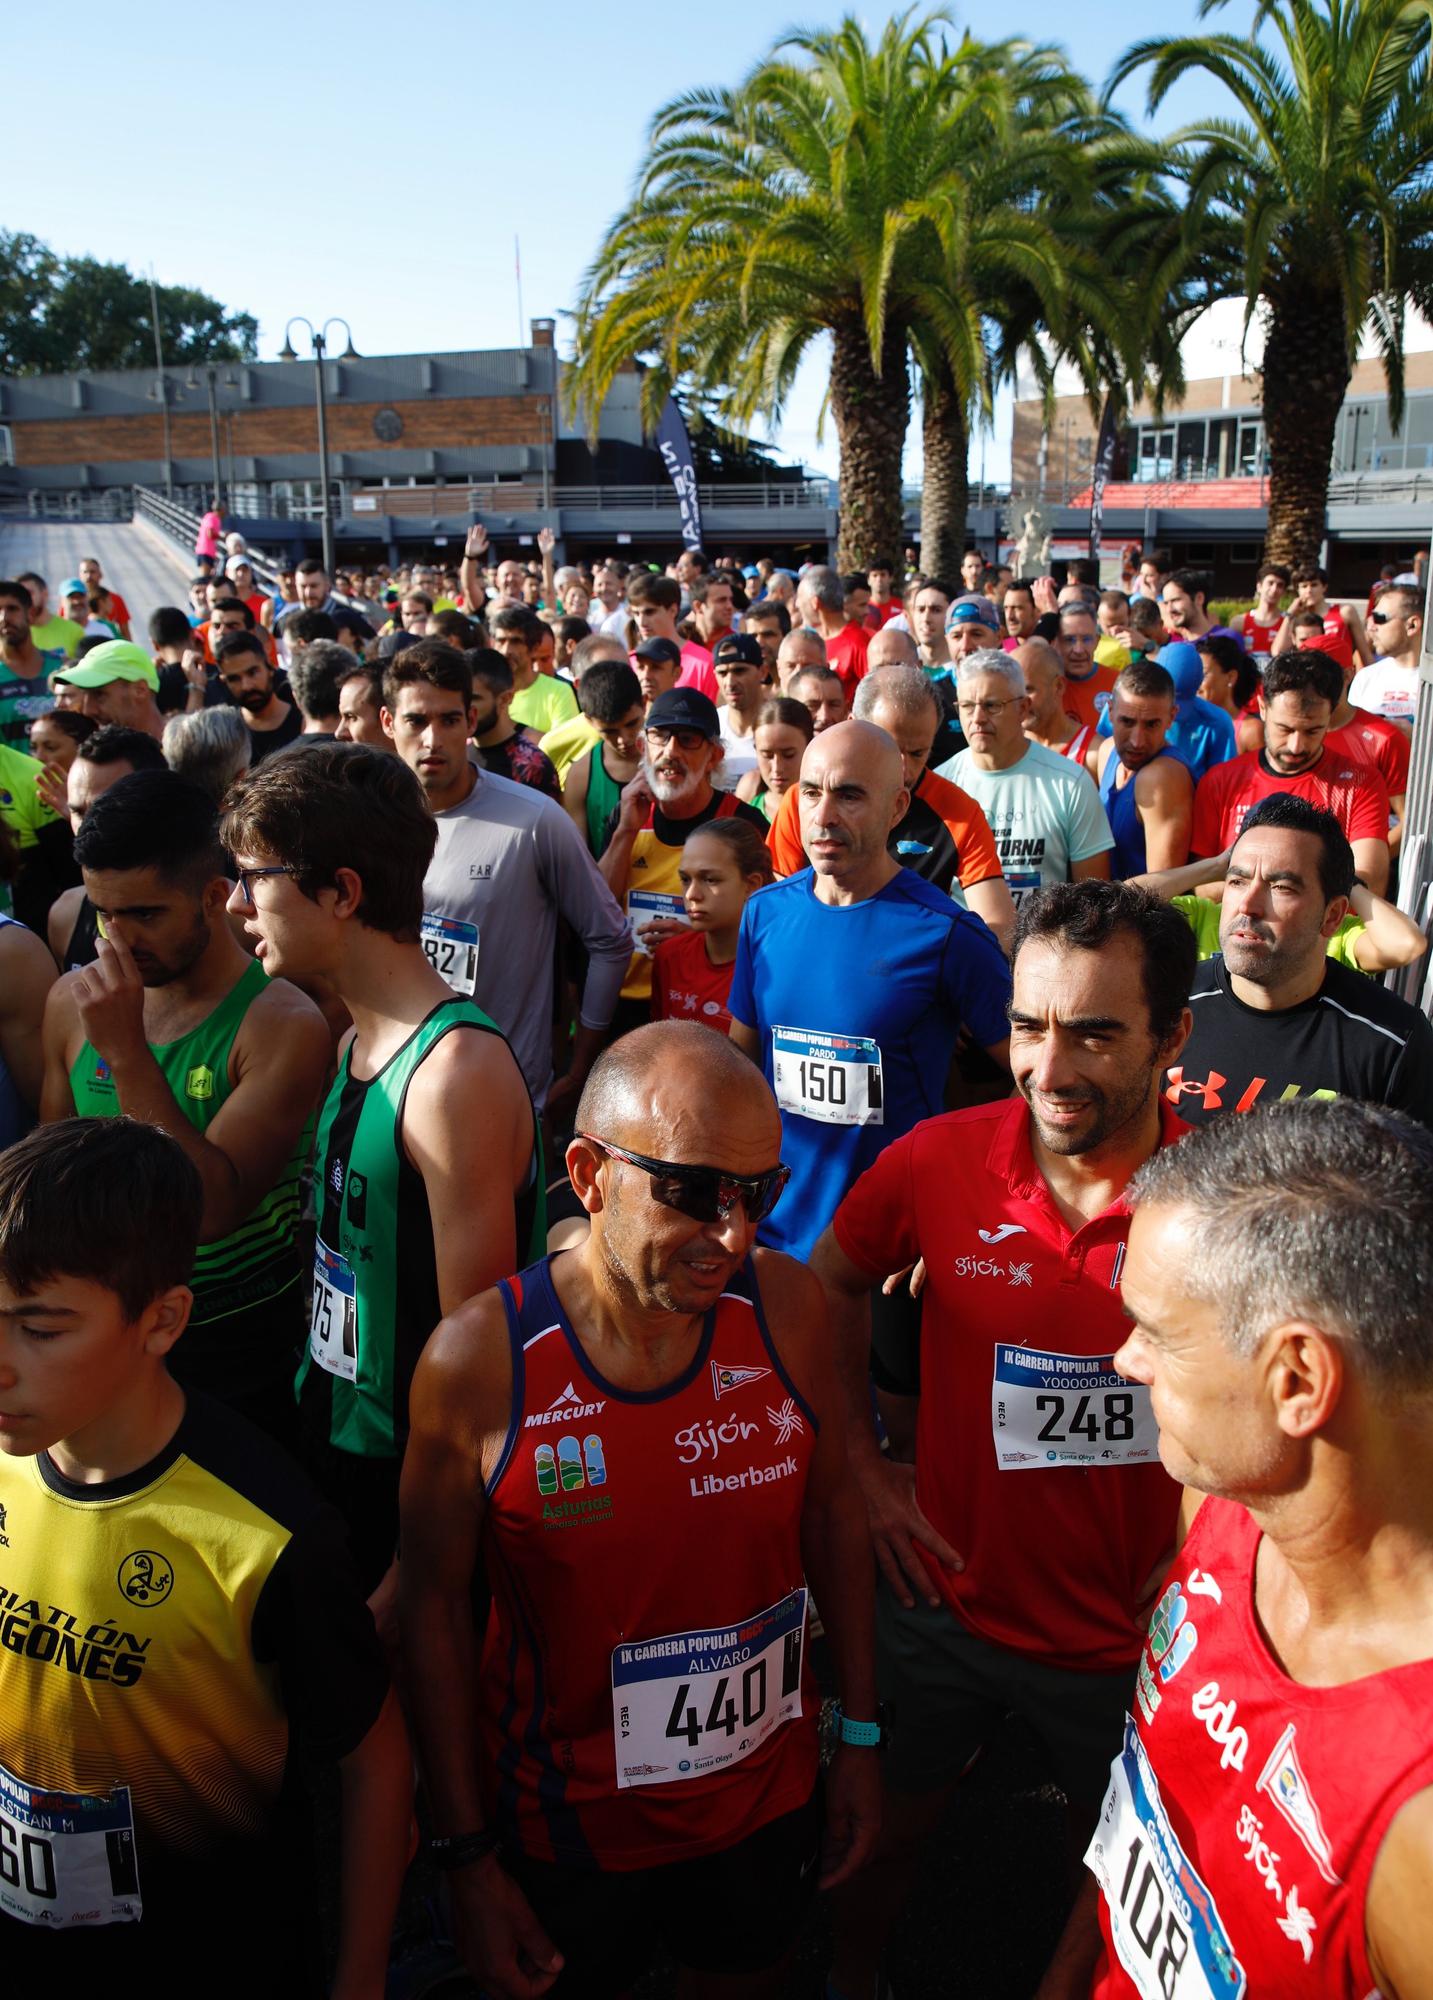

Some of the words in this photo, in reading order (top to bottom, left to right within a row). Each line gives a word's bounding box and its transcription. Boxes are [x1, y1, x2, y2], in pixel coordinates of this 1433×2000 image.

[469, 864, 492, 877] FAR
[809, 1046, 836, 1060] PARDO
[799, 1060, 846, 1105] 150
[955, 1254, 1005, 1279] gijón
[313, 1279, 333, 1343] 75
[1004, 1350, 1013, 1364] IX
[1014, 1352, 1055, 1373] CARRERA
[1056, 1360, 1100, 1374] POPULAR
[524, 1400, 608, 1428] MERCURY
[998, 1401, 1006, 1420] REC
[998, 1420, 1006, 1428] A
[1036, 1393, 1134, 1443] 248
[674, 1412, 760, 1464] gijón
[689, 1455, 799, 1498] Liberbank
[541, 1495, 613, 1520] Asturias
[0, 1609, 146, 1688] GONES
[621, 1649, 632, 1665] IX
[634, 1637, 687, 1663] CARRERA
[688, 1631, 738, 1653] POPULAR
[688, 1646, 751, 1674] ALVARO
[620, 1706, 629, 1728] REC
[665, 1657, 767, 1747] 440
[621, 1730, 630, 1738] A
[1191, 1681, 1249, 1773] edp
[694, 1759, 714, 1770] Santa
[715, 1752, 733, 1764] Olaya
[0, 1773, 30, 1806] OPULAR
[0, 1793, 52, 1830] ISTIAN
[62, 1818, 75, 1833] M
[0, 1817, 57, 1899] 60
[1236, 1804, 1282, 1902] gijón
[1119, 1835, 1188, 2000] 108
